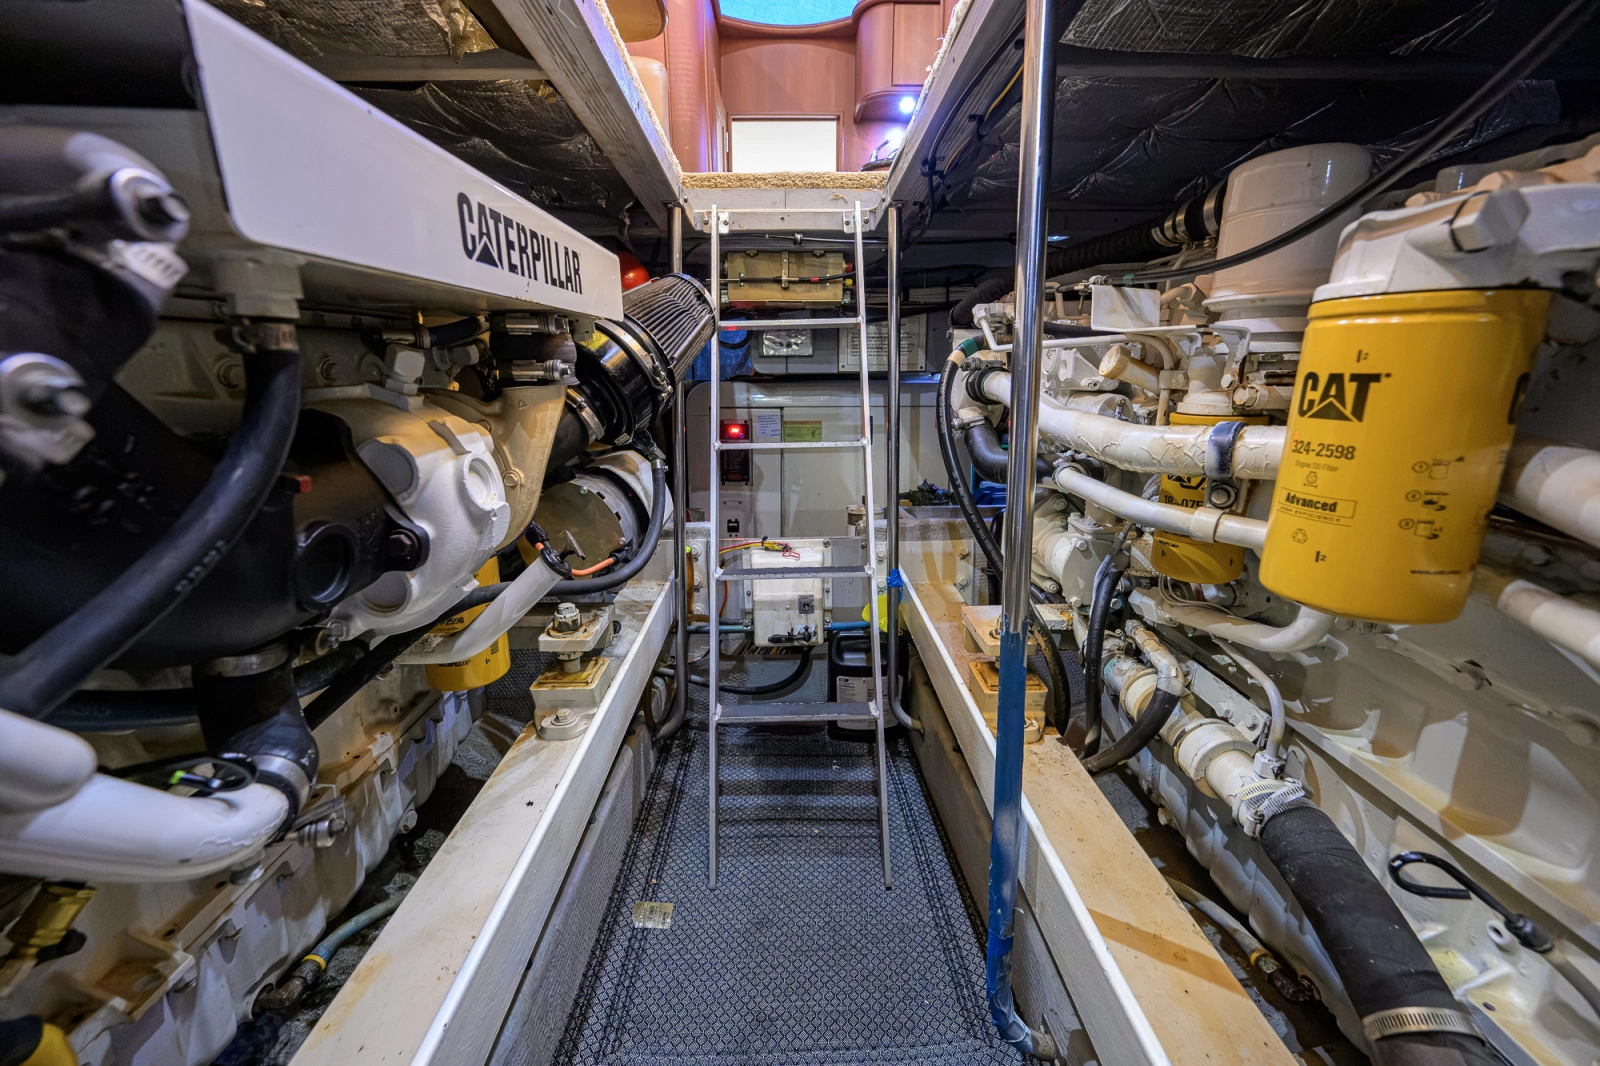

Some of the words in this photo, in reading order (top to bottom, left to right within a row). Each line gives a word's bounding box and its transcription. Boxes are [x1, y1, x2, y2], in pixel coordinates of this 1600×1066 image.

[457, 192, 582, 294] CATERPILLAR
[1298, 371, 1383, 422] CAT
[1291, 439, 1356, 460] 324-2598
[1285, 492, 1338, 513] Advanced
